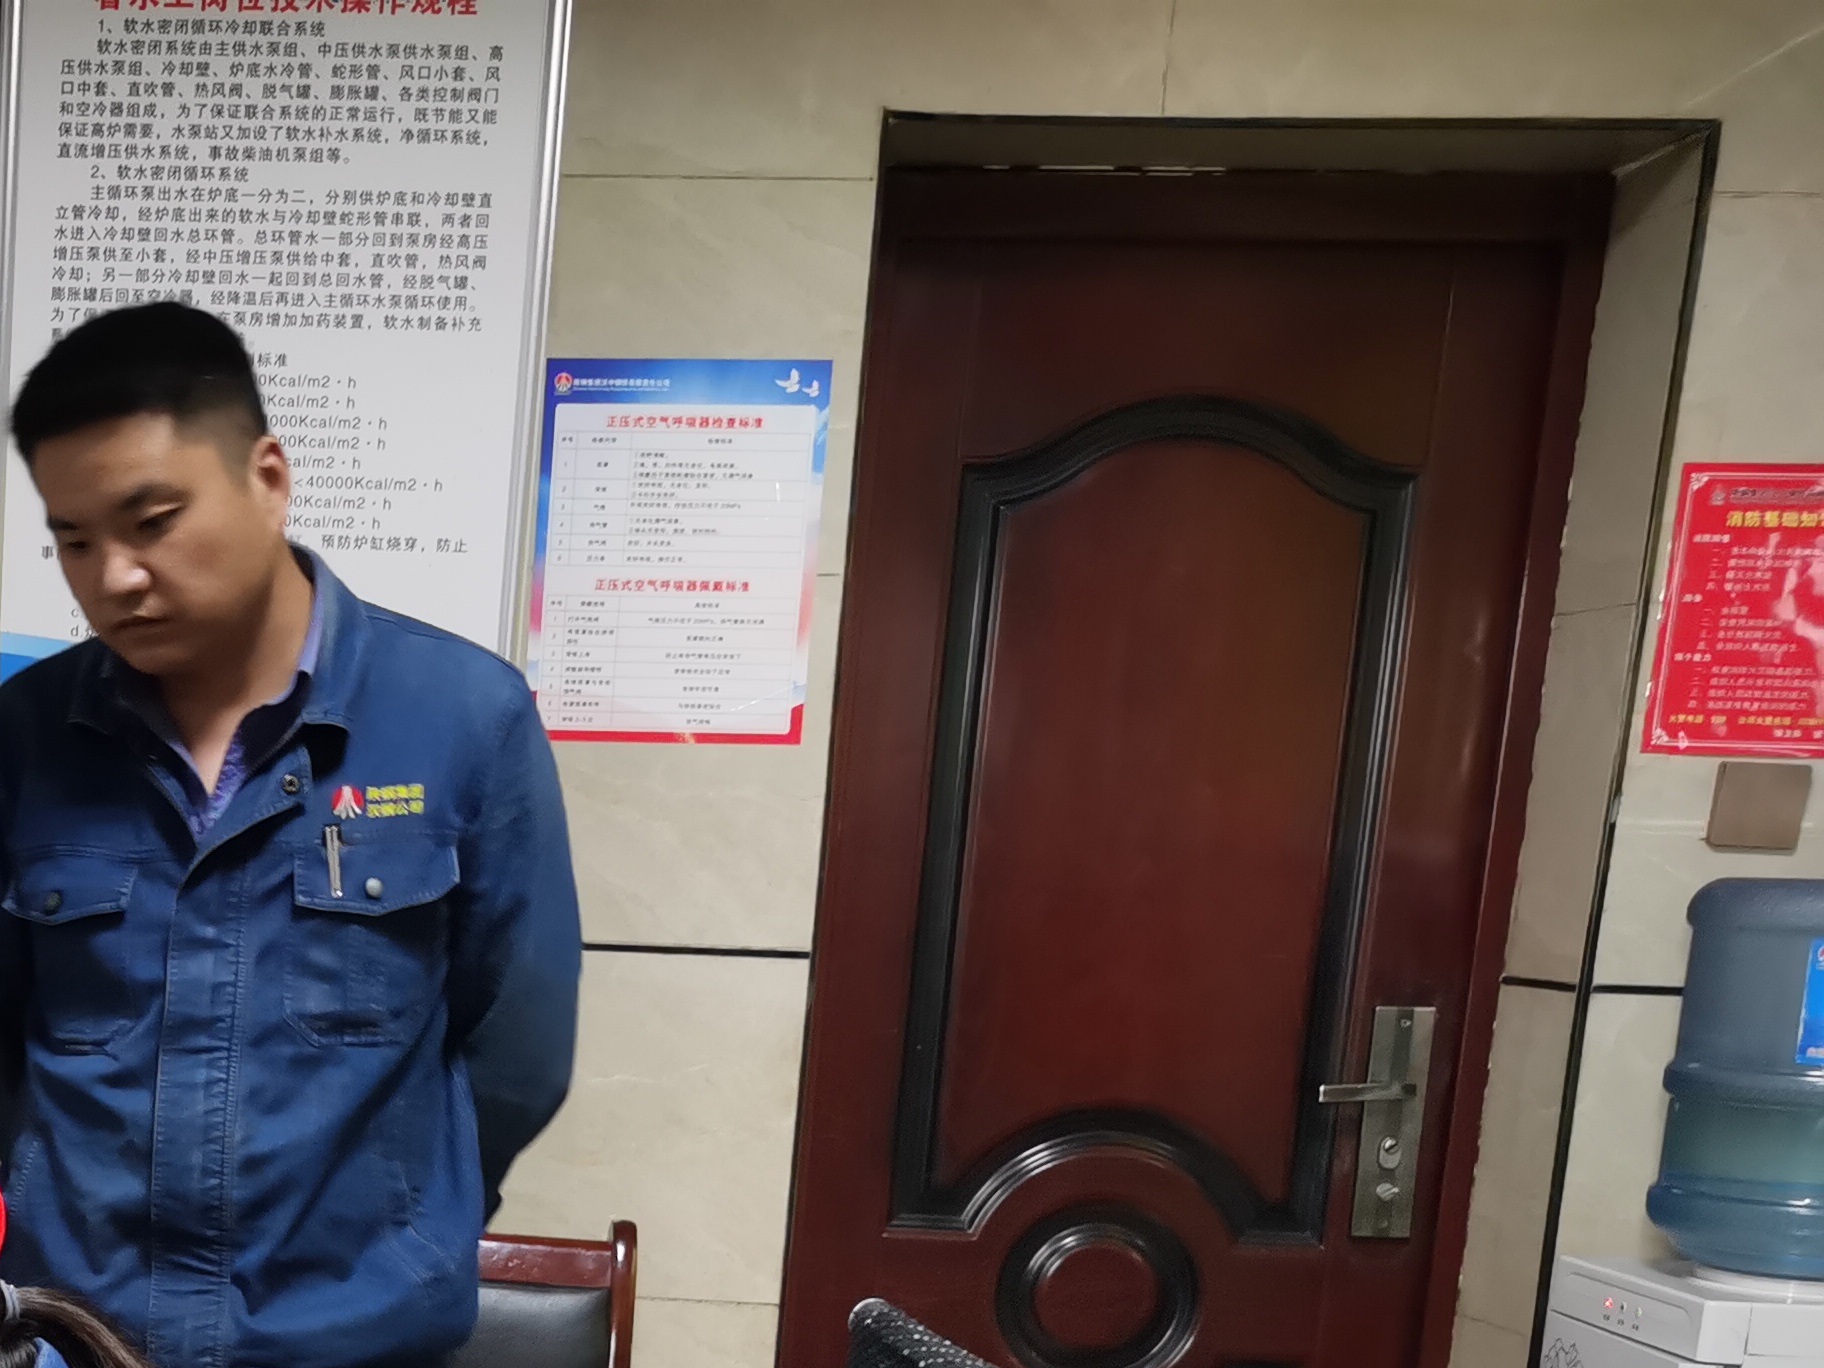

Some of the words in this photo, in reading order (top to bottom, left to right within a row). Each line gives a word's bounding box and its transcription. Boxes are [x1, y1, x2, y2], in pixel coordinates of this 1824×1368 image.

[99, 18, 325, 37] 1、软水密闭循环冷却联合系统
[61, 59, 501, 83] 压供水泵组、冷却壁、炉底水冷管、蛇形管、风口小套、风
[61, 80, 499, 104] 口中套、直吹管、热风阀、脱气罐、膨胀罐、各类控制阀门
[60, 101, 498, 125] 和空冷器组成，为了保证联合系统的正常运行，既节能又能
[57, 143, 351, 165] 直流增压供水系统，事故柴油机泵组等。
[90, 165, 249, 183] 2、软水密闭循环系统
[90, 184, 493, 209] 主循环泵出水在炉底一分为二，分别供炉底和冷却壁直
[55, 204, 490, 230] 立管冷却，经炉底出来的软水与冷却壁蛇形管串联，两者回
[54, 226, 489, 250] 水进入冷却壁回水总环管。总环管水一部分回到泵房经高压
[606, 415, 763, 429] 正压式空气呼吸器检查标准
[595, 578, 750, 593] 正压式空气呼吸器佩戴标准
